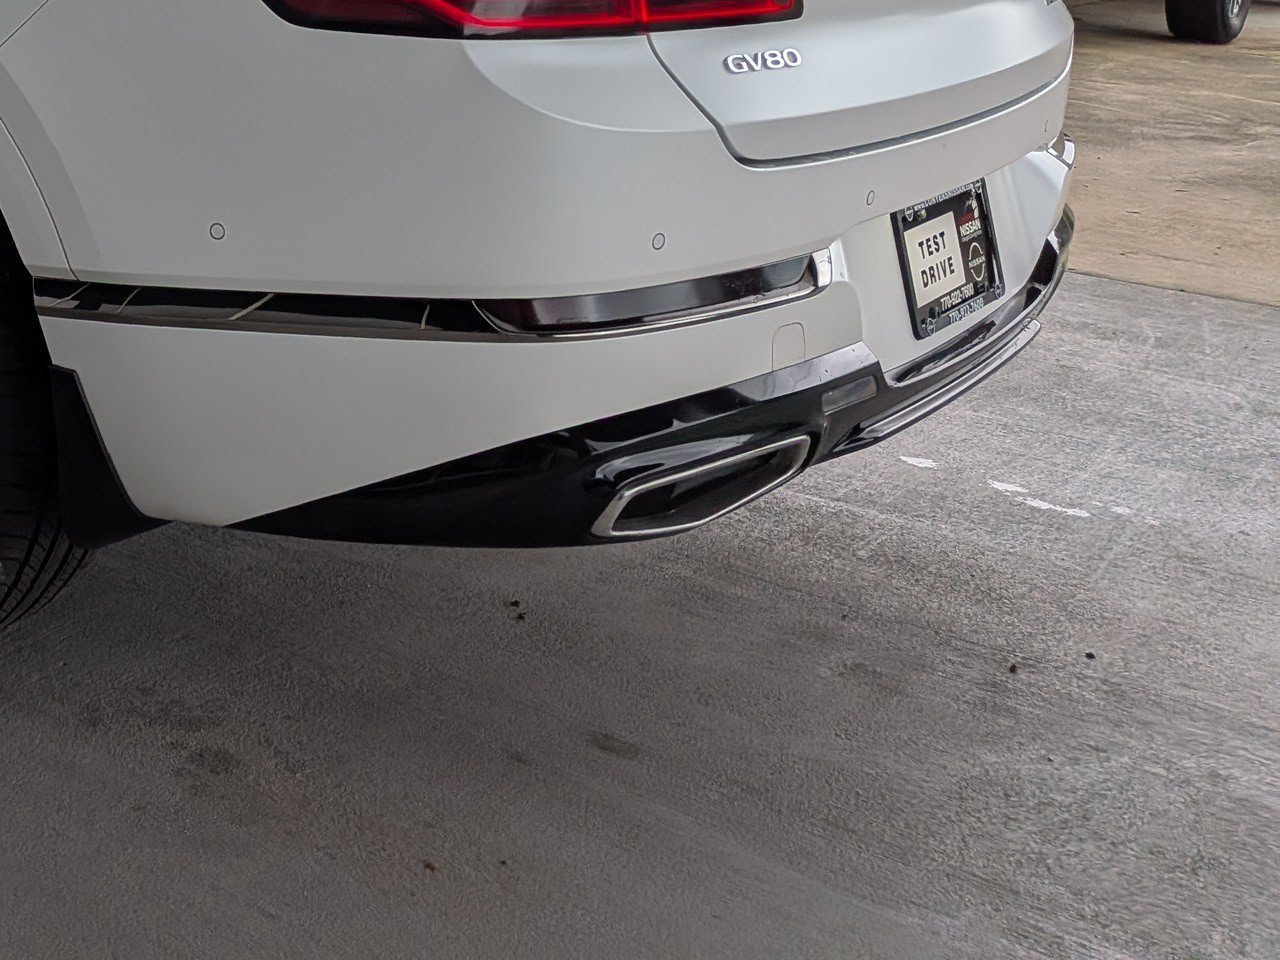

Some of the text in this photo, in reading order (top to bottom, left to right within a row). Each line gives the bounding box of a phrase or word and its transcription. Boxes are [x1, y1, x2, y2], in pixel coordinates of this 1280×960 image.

[723, 48, 802, 74] GV80
[959, 218, 981, 237] NISSAN
[918, 231, 945, 259] TEST
[921, 256, 955, 288] DRIVE
